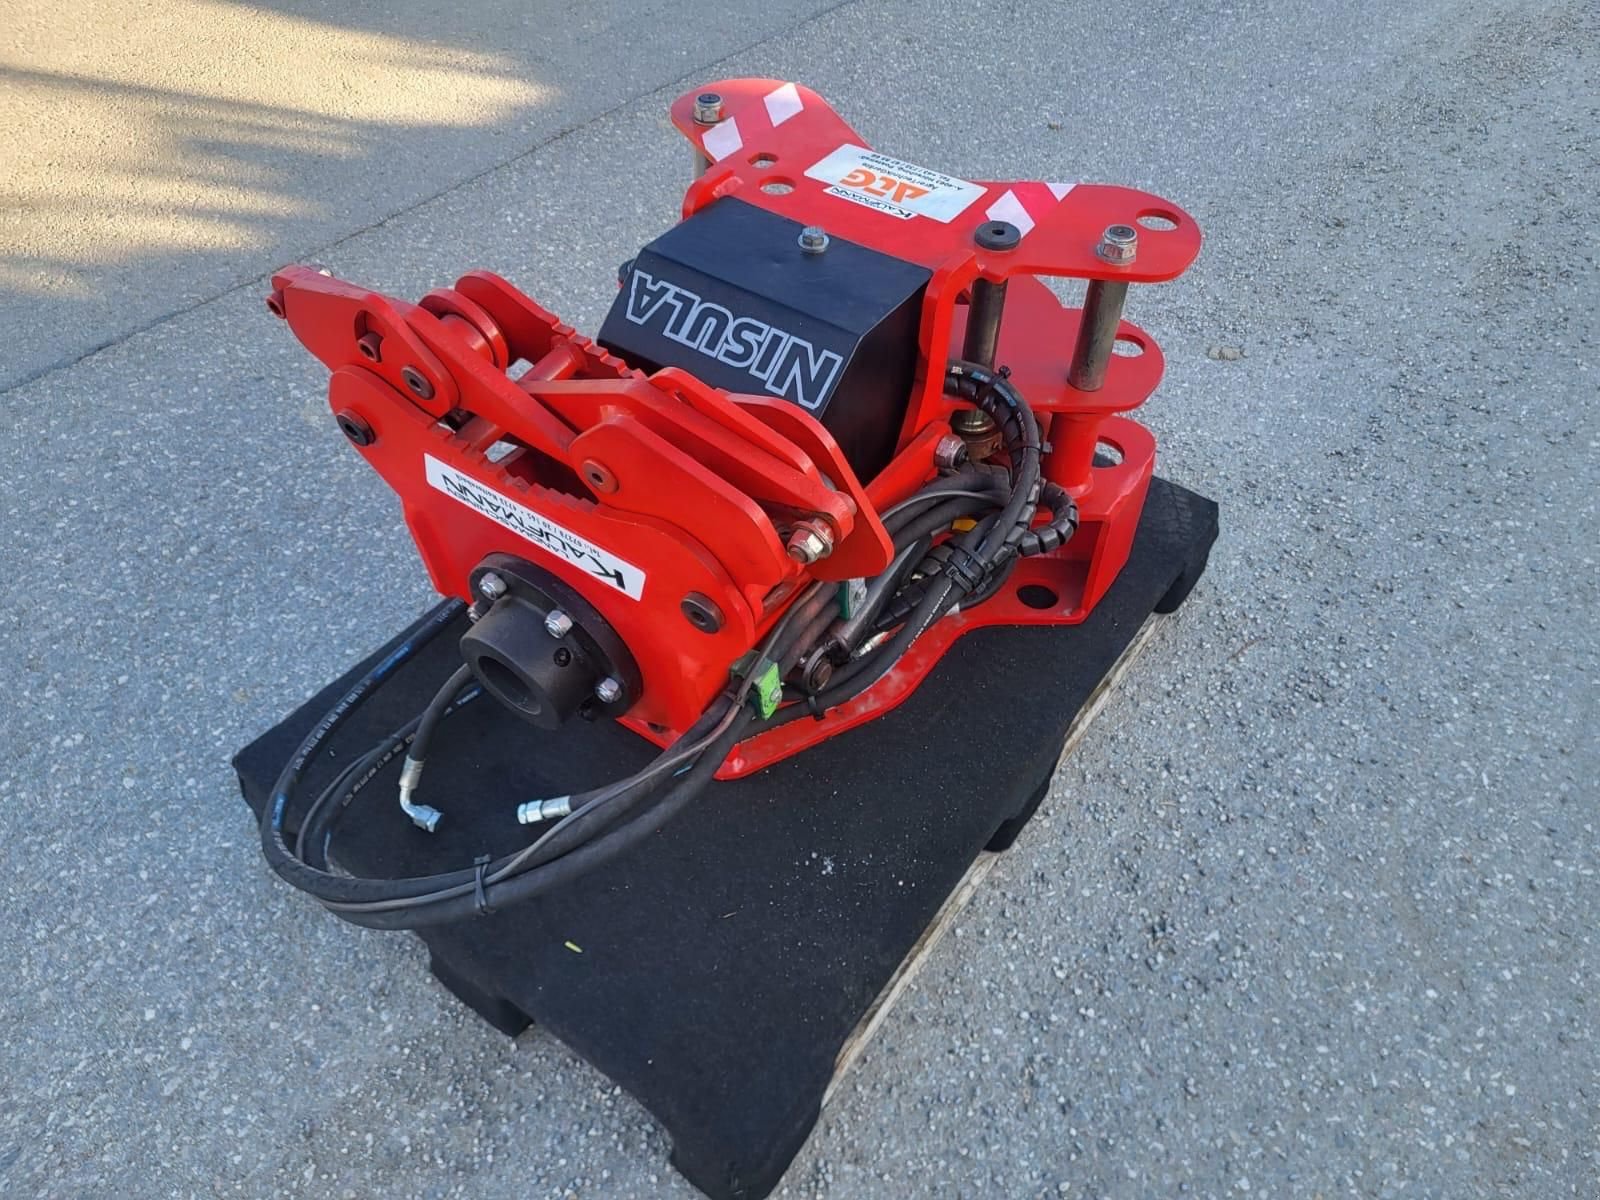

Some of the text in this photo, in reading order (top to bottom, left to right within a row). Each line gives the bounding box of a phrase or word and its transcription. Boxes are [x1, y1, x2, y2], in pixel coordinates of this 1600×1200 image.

[831, 187, 912, 218] KAUFMANN
[625, 268, 844, 411] NISULA
[441, 473, 626, 591] KAUFMANN
